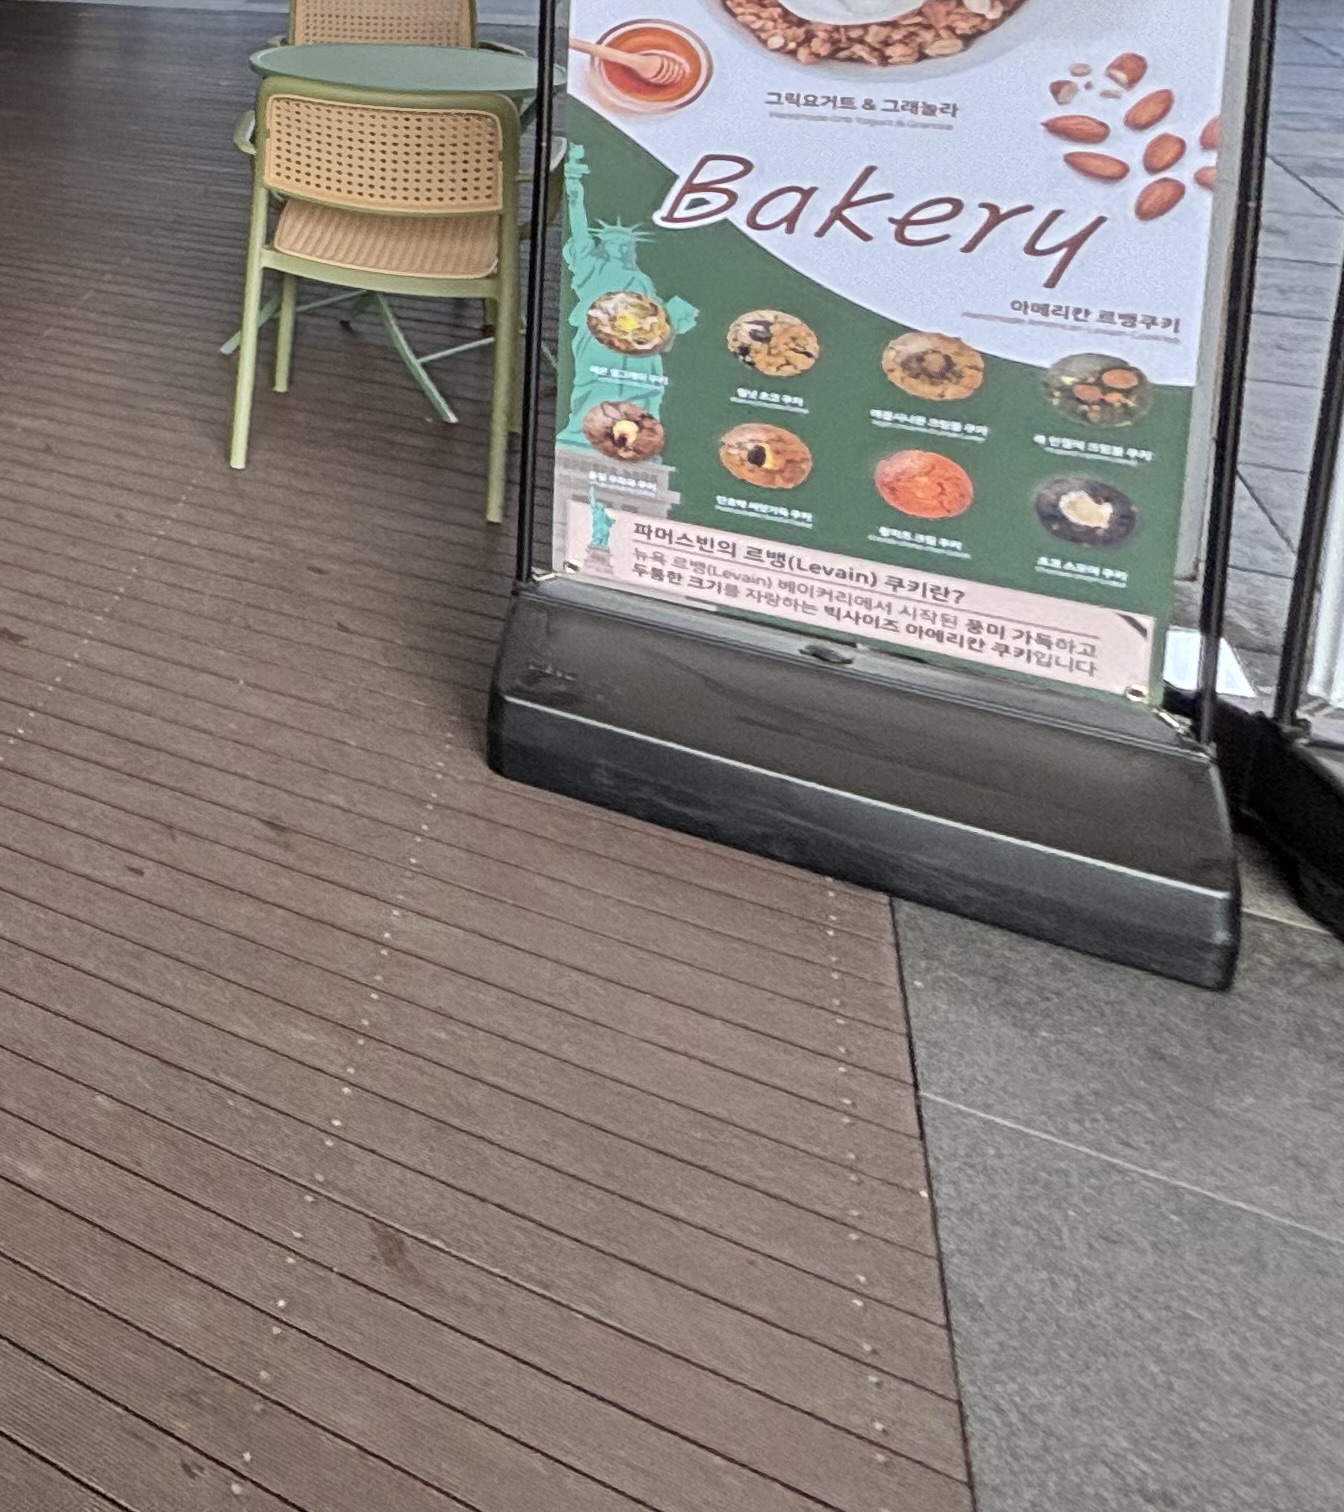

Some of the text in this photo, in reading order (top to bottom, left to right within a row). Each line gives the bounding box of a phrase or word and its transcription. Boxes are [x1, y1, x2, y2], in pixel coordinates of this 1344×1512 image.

[764, 91, 960, 118] 그릭요거트 & 그래놀라
[653, 149, 1112, 291] Bakery
[1010, 298, 1092, 323] 아메리칸
[1095, 309, 1182, 334] 르뱅쿠키
[632, 547, 1098, 658] 뉴욕 르뱅(Levain) 베이커리에서 시작된 풍미 가득하고
[633, 522, 966, 605] 파머스빈의 르뱅(Levain) 쿠키란?
[631, 562, 683, 586] 두툼한
[687, 575, 741, 599] 크기를
[744, 588, 819, 616] 자랑하는
[823, 603, 901, 634] 빅사이즈
[990, 643, 1098, 678] 쿠키입니다
